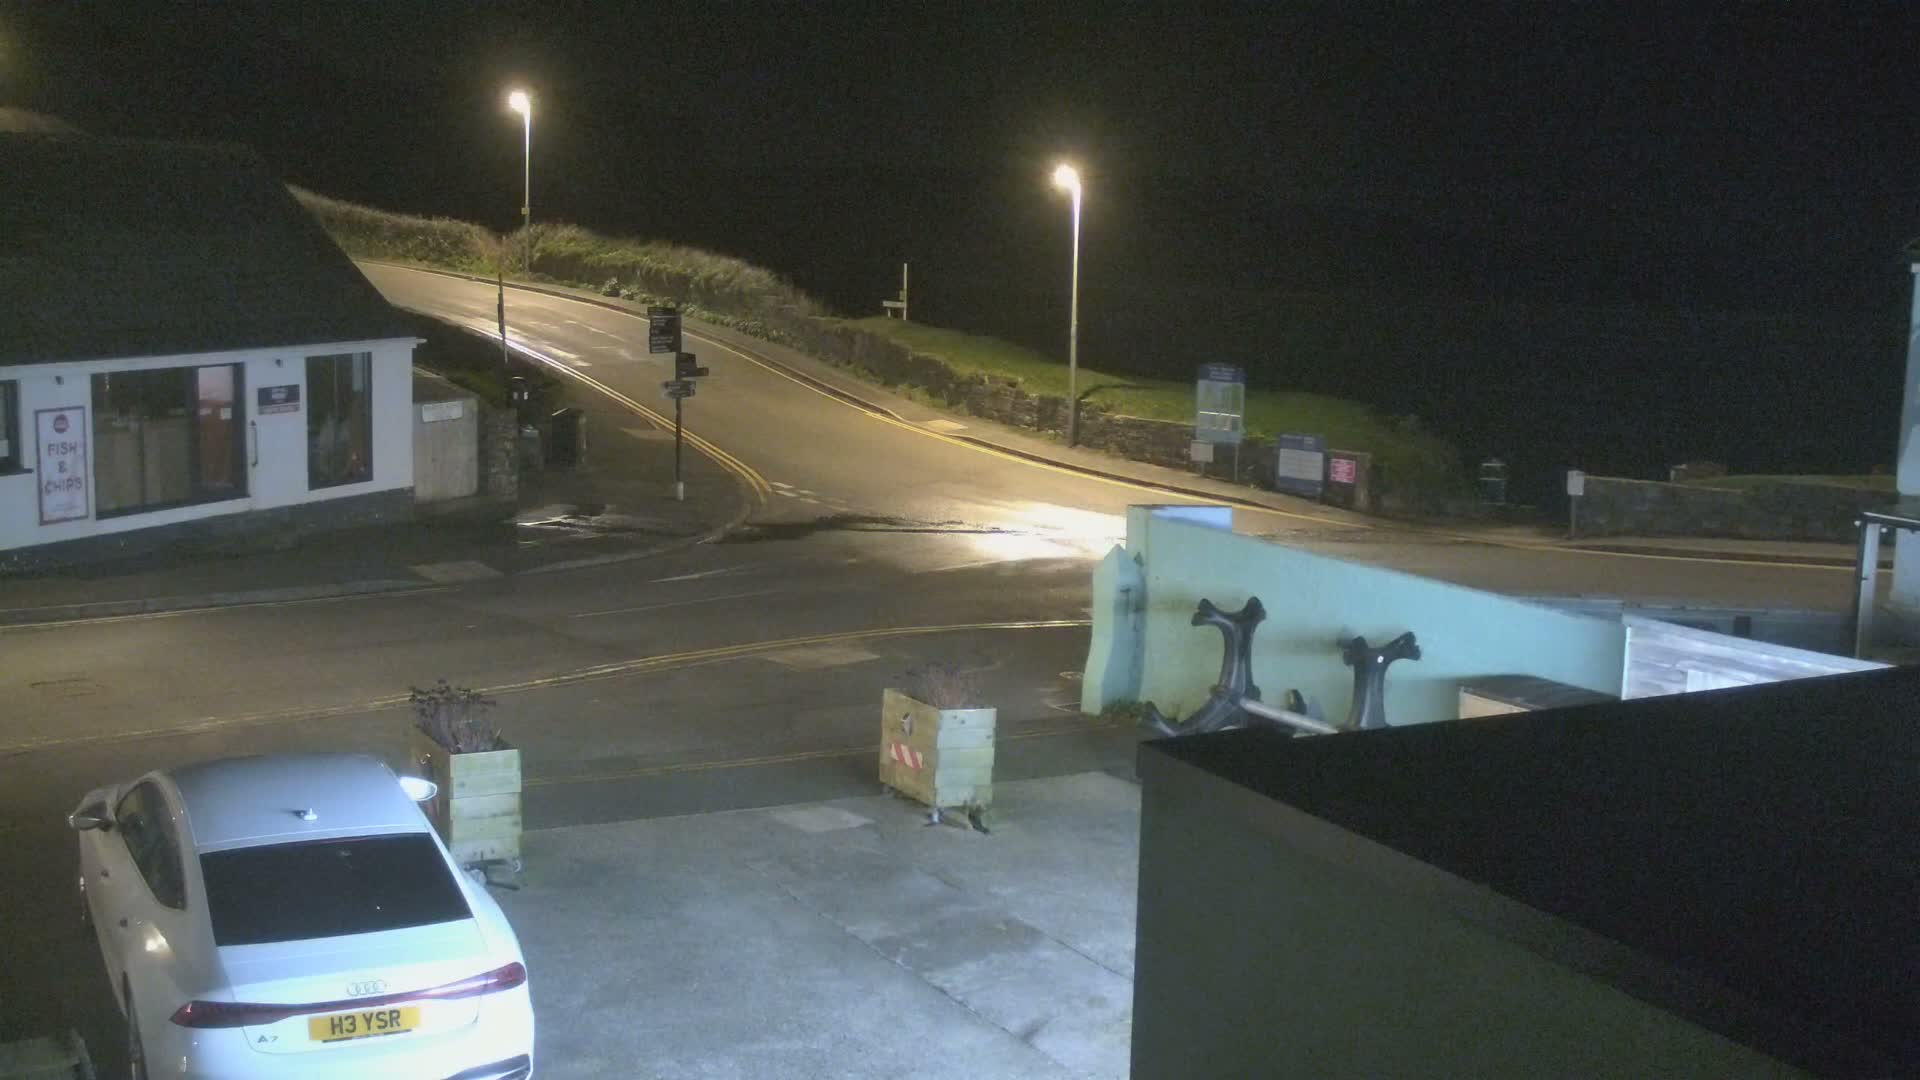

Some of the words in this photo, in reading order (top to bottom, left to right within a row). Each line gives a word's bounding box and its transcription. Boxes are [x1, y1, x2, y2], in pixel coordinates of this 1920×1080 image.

[47, 441, 78, 457] FISH
[57, 460, 67, 474] &
[44, 477, 82, 495] CHIPS
[331, 1016, 357, 1035] H3
[362, 1009, 401, 1032] YSR
[257, 1035, 279, 1044] A7
